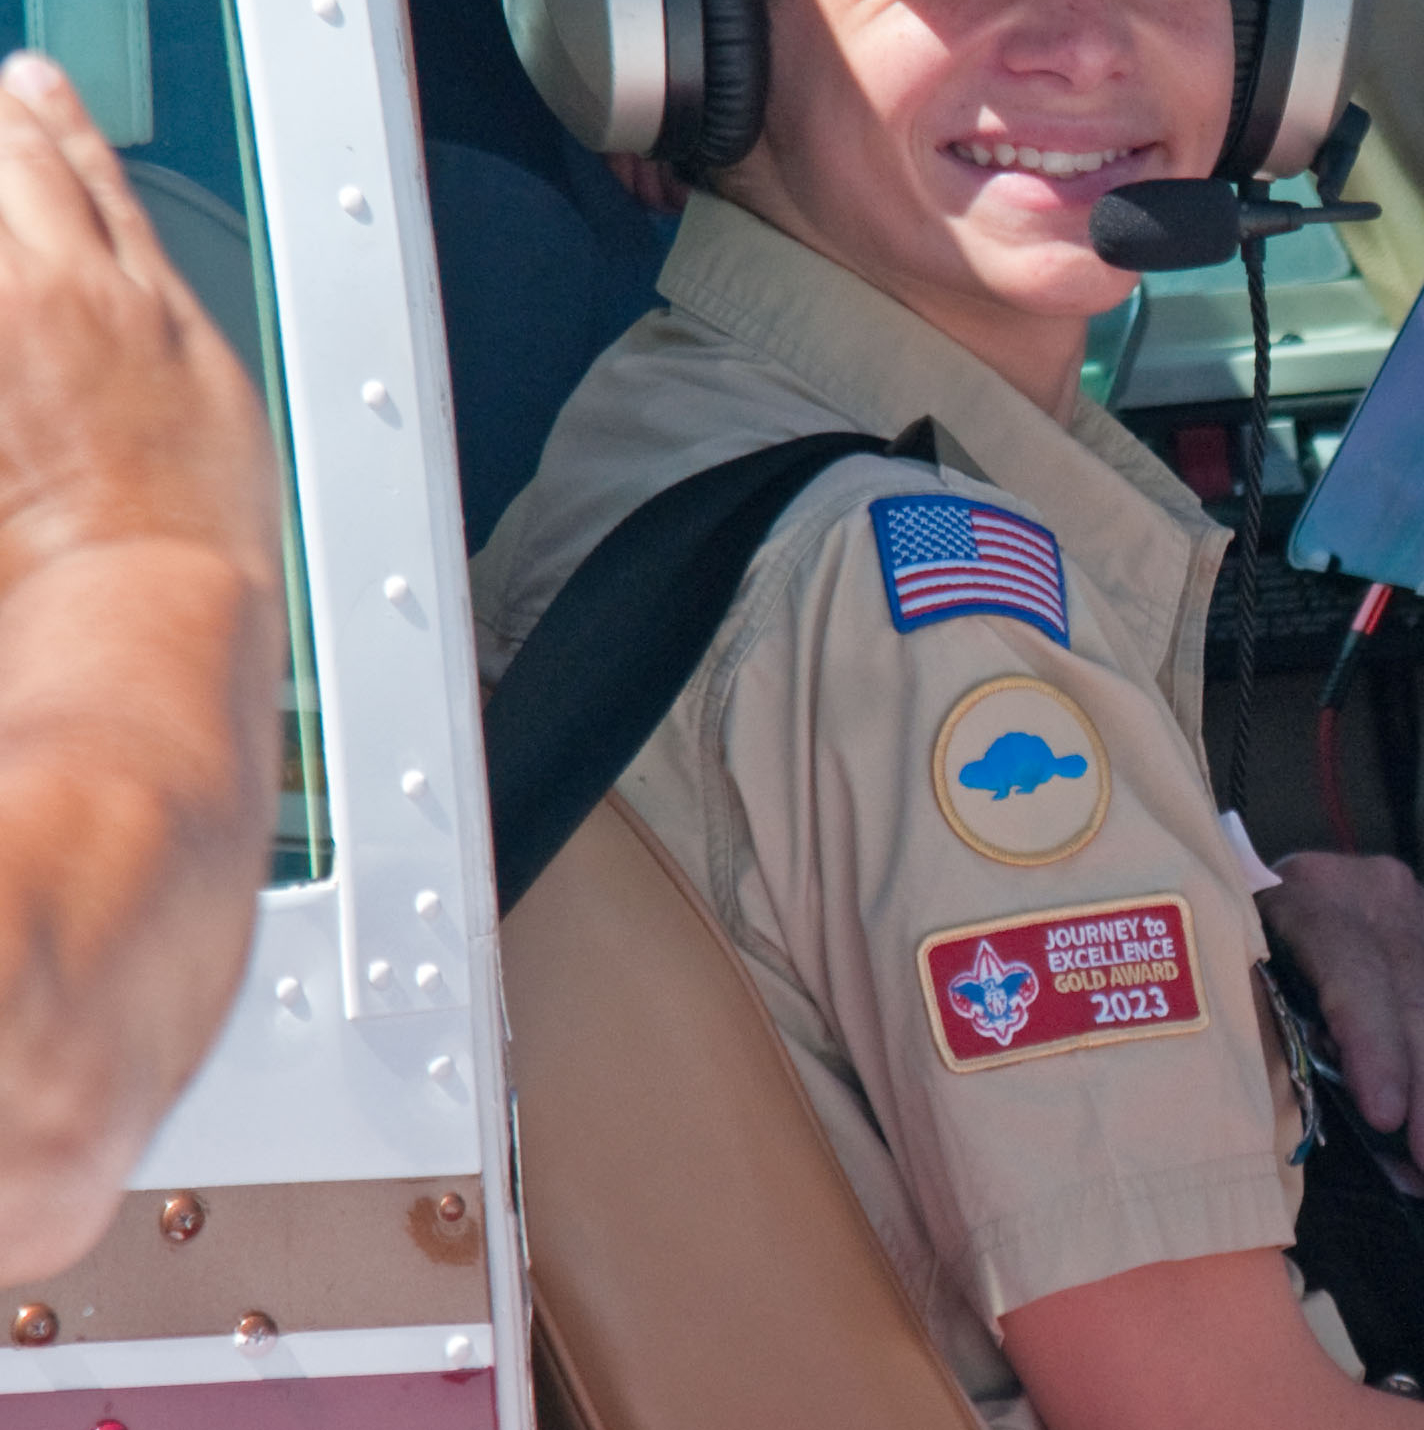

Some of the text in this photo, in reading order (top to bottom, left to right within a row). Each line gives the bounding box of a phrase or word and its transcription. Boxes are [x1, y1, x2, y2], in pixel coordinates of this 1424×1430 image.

[1045, 916, 1167, 950] JOURNEY to
[1048, 937, 1177, 973] EXCELLENCE
[1054, 960, 1179, 994] GOLD AWARD
[1090, 984, 1170, 1024] 2023
